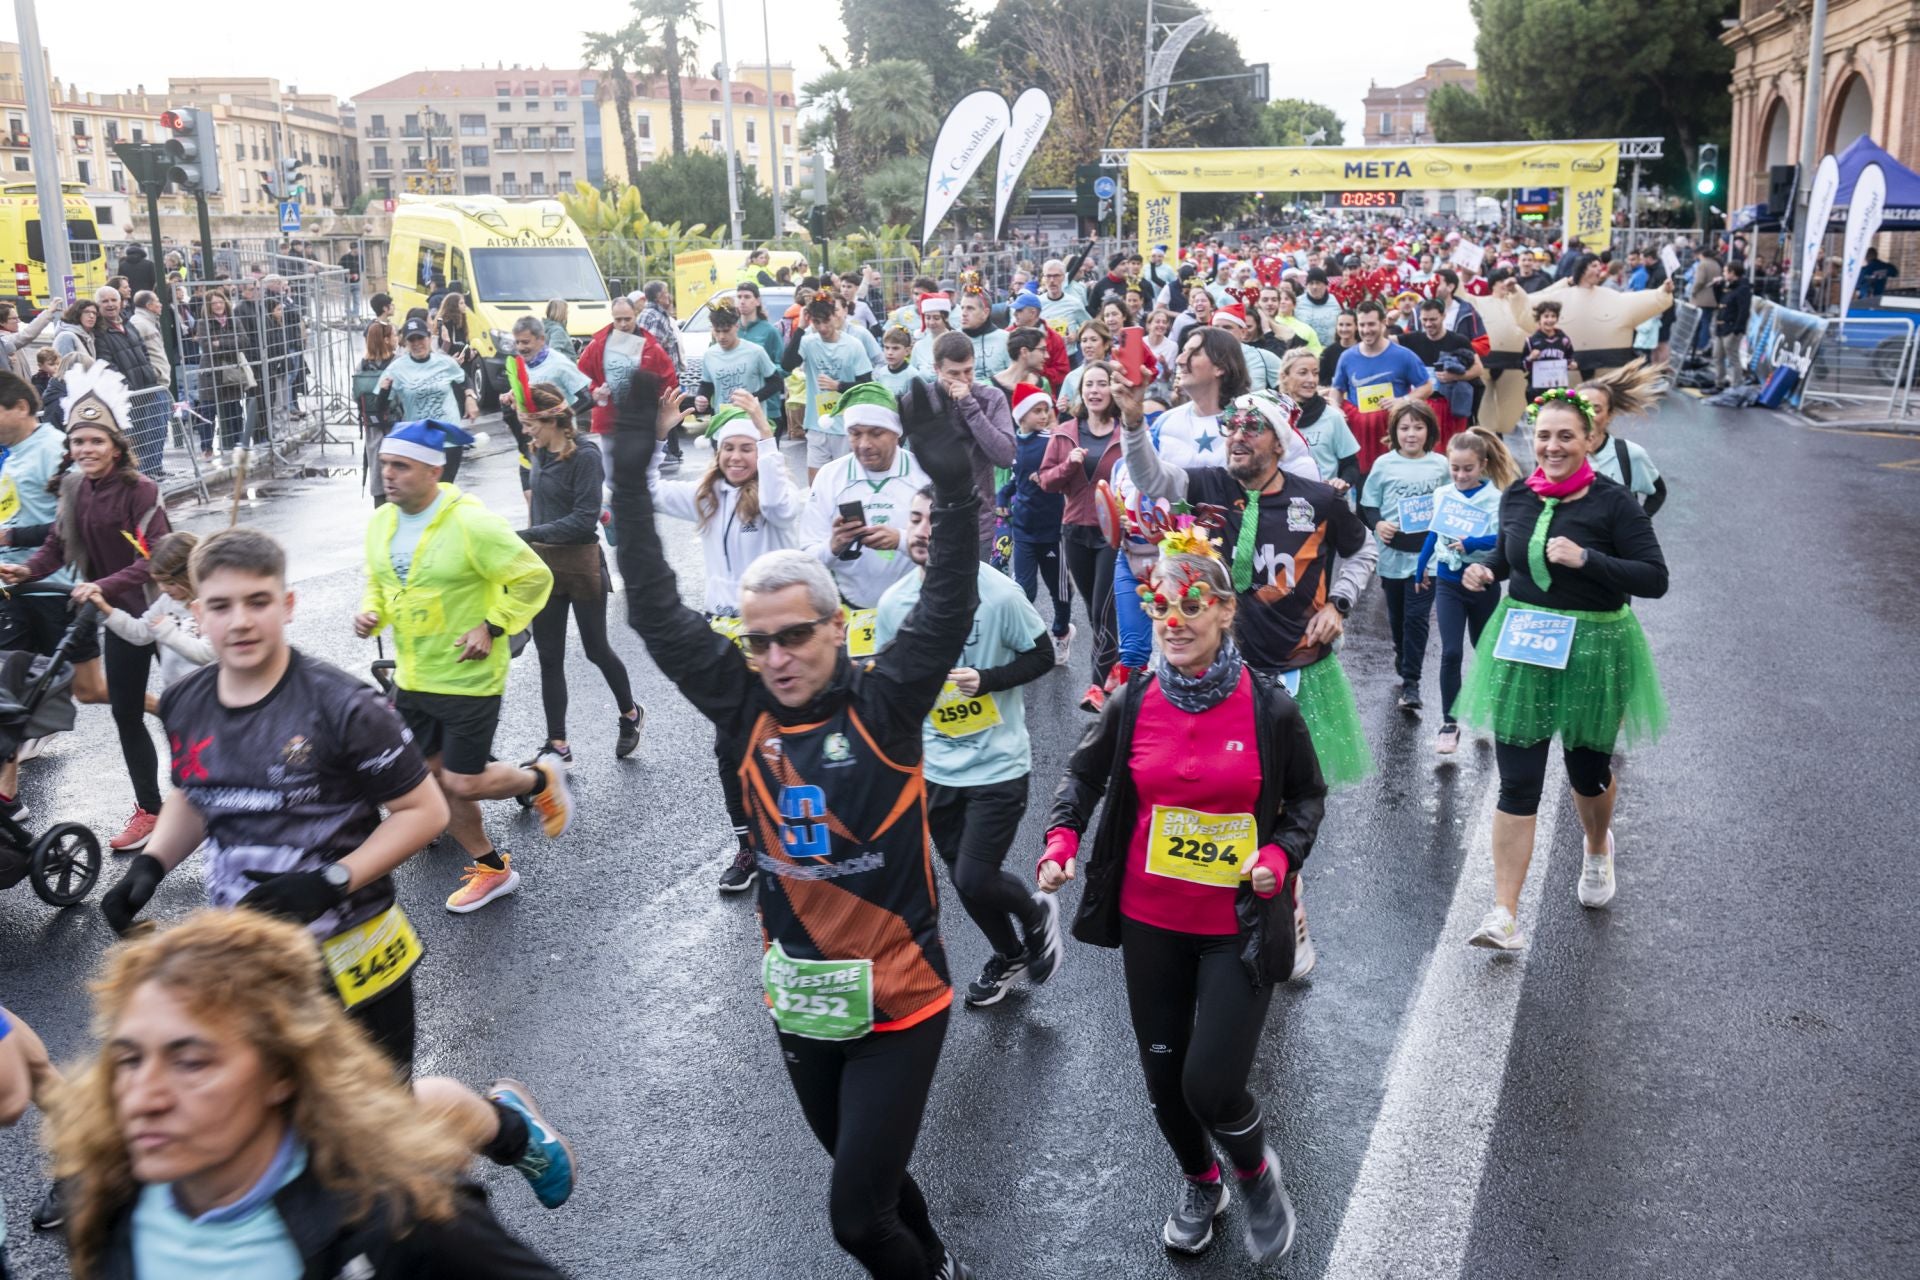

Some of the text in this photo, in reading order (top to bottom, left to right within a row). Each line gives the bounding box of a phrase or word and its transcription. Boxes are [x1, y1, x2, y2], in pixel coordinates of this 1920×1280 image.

[950, 115, 998, 171] CaixaBank
[1008, 112, 1046, 169] CaixaBank
[1344, 160, 1413, 179] META
[1341, 192, 1397, 206] 0:02:57
[1577, 188, 1605, 201] SAN
[1146, 196, 1171, 209] SAN
[1581, 200, 1598, 209] SIL
[1150, 207, 1165, 218] SIL
[1578, 208, 1602, 220] VES
[1148, 216, 1169, 227] VES
[1578, 218, 1602, 230] TRE
[1148, 225, 1169, 237] TRE
[1508, 631, 1557, 652] 3730
[937, 701, 982, 723] 2590
[1164, 811, 1199, 825] SAN
[1162, 818, 1252, 837] SILVESTRE
[1212, 832, 1249, 842] MURCIA
[1168, 837, 1239, 866] 2294
